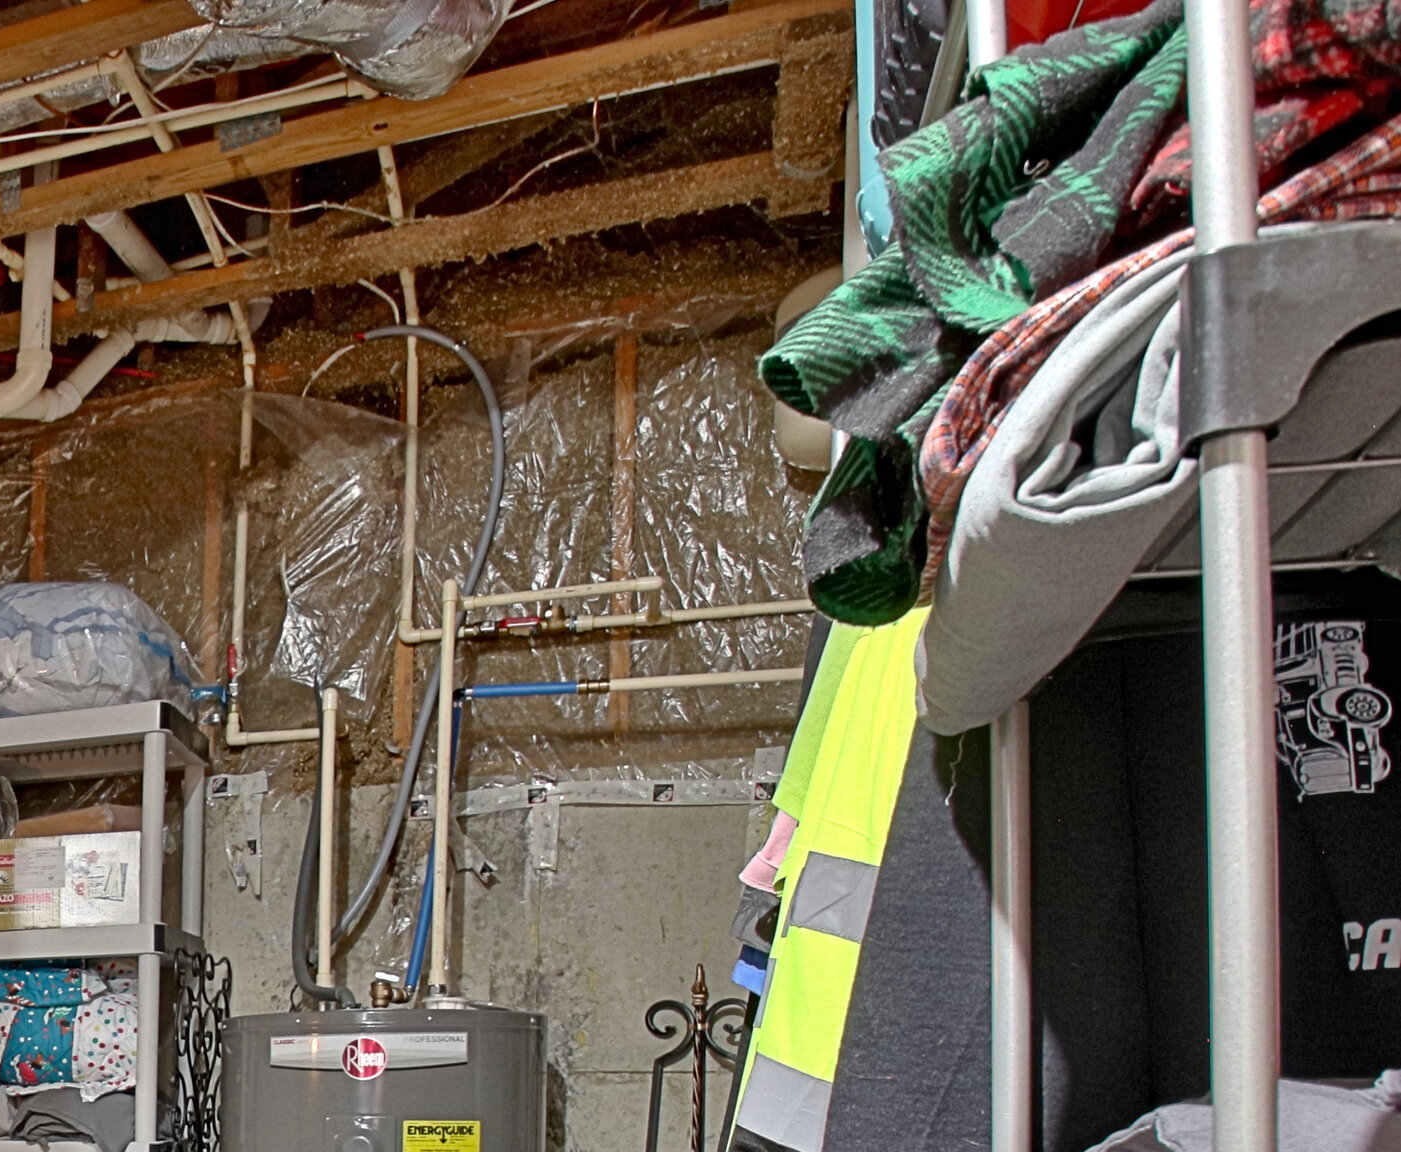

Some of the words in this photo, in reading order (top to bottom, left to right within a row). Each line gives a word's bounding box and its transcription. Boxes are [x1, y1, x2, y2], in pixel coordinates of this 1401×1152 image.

[404, 1035, 465, 1043] PROFESSIONAL
[347, 1037, 384, 1073] Rheem
[407, 1125, 475, 1136] ENERGYGUIDE
